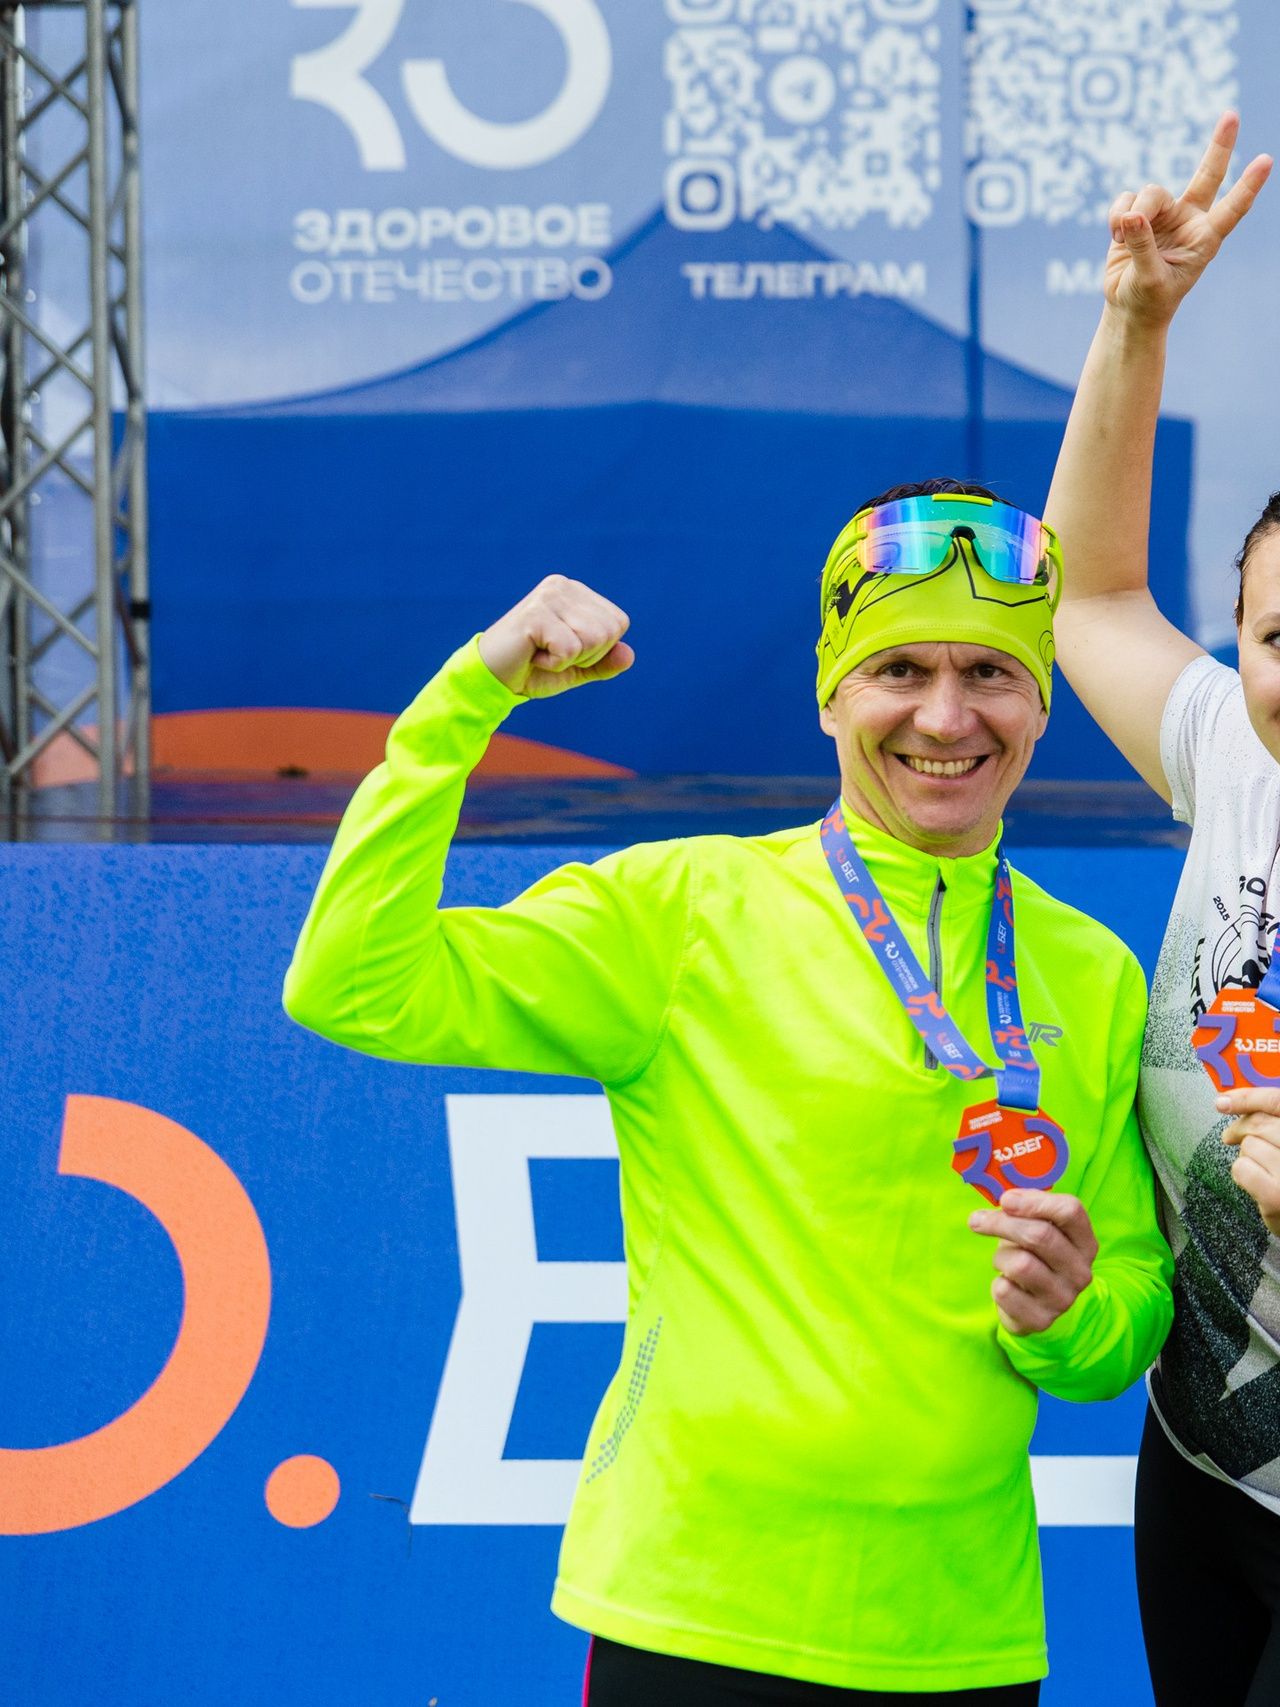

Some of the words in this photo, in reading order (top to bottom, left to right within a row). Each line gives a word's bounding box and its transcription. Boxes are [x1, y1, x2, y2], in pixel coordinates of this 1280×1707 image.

[294, 204, 612, 256] ЗДОРОВОЕ
[290, 257, 612, 303] ОТЕЧЕСТВО
[685, 262, 926, 299] ТЕЛЕГРАМ
[1213, 896, 1231, 921] 2015
